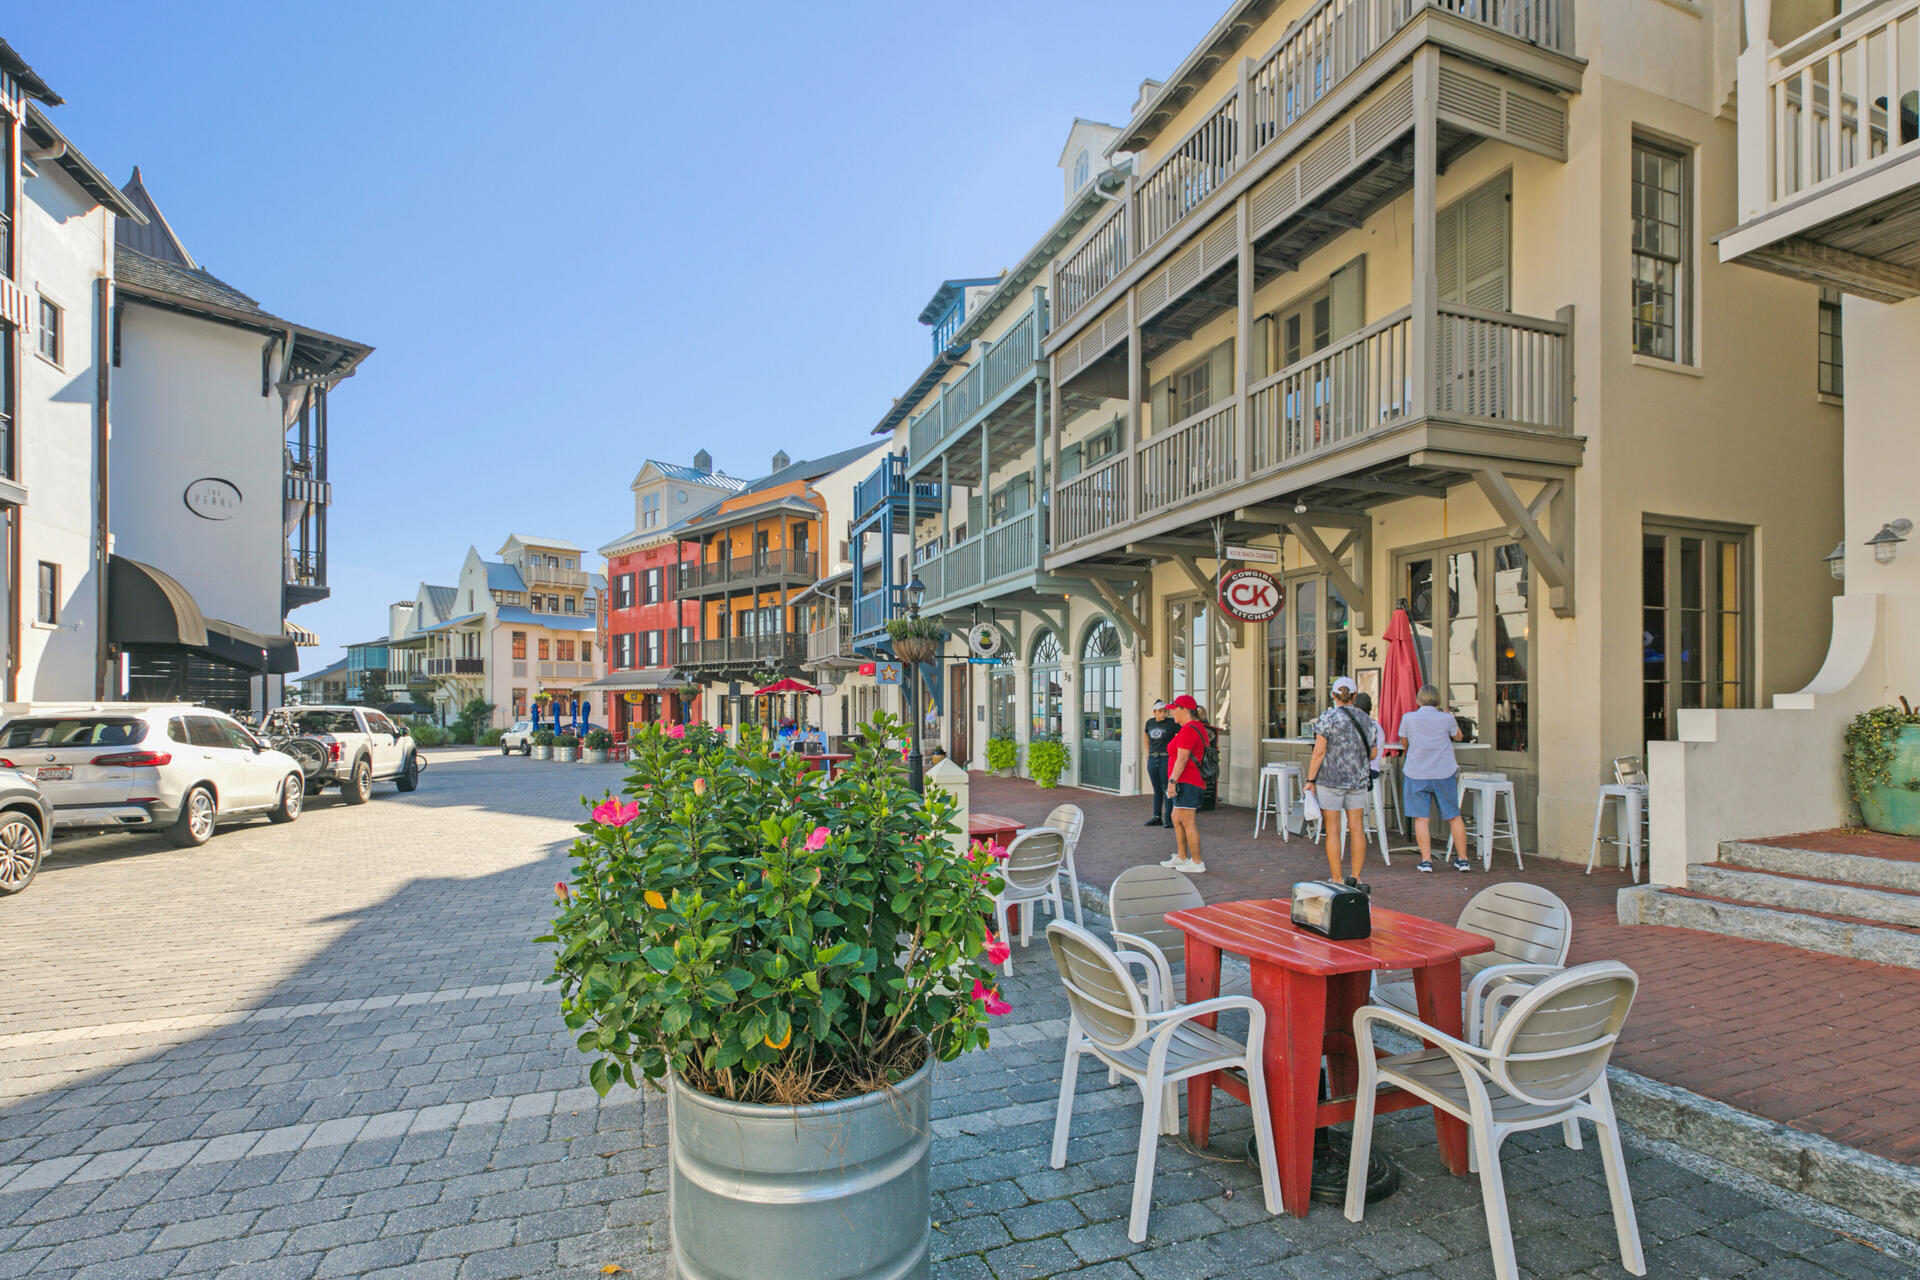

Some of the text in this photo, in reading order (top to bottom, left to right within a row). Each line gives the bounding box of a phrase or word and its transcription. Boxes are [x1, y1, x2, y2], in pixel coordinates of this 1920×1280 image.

[1231, 570, 1274, 584] COWGIRL
[1231, 583, 1271, 607] CK
[1231, 607, 1274, 620] KITCHEN
[1359, 643, 1377, 661] 54
[1064, 671, 1072, 682] 58
